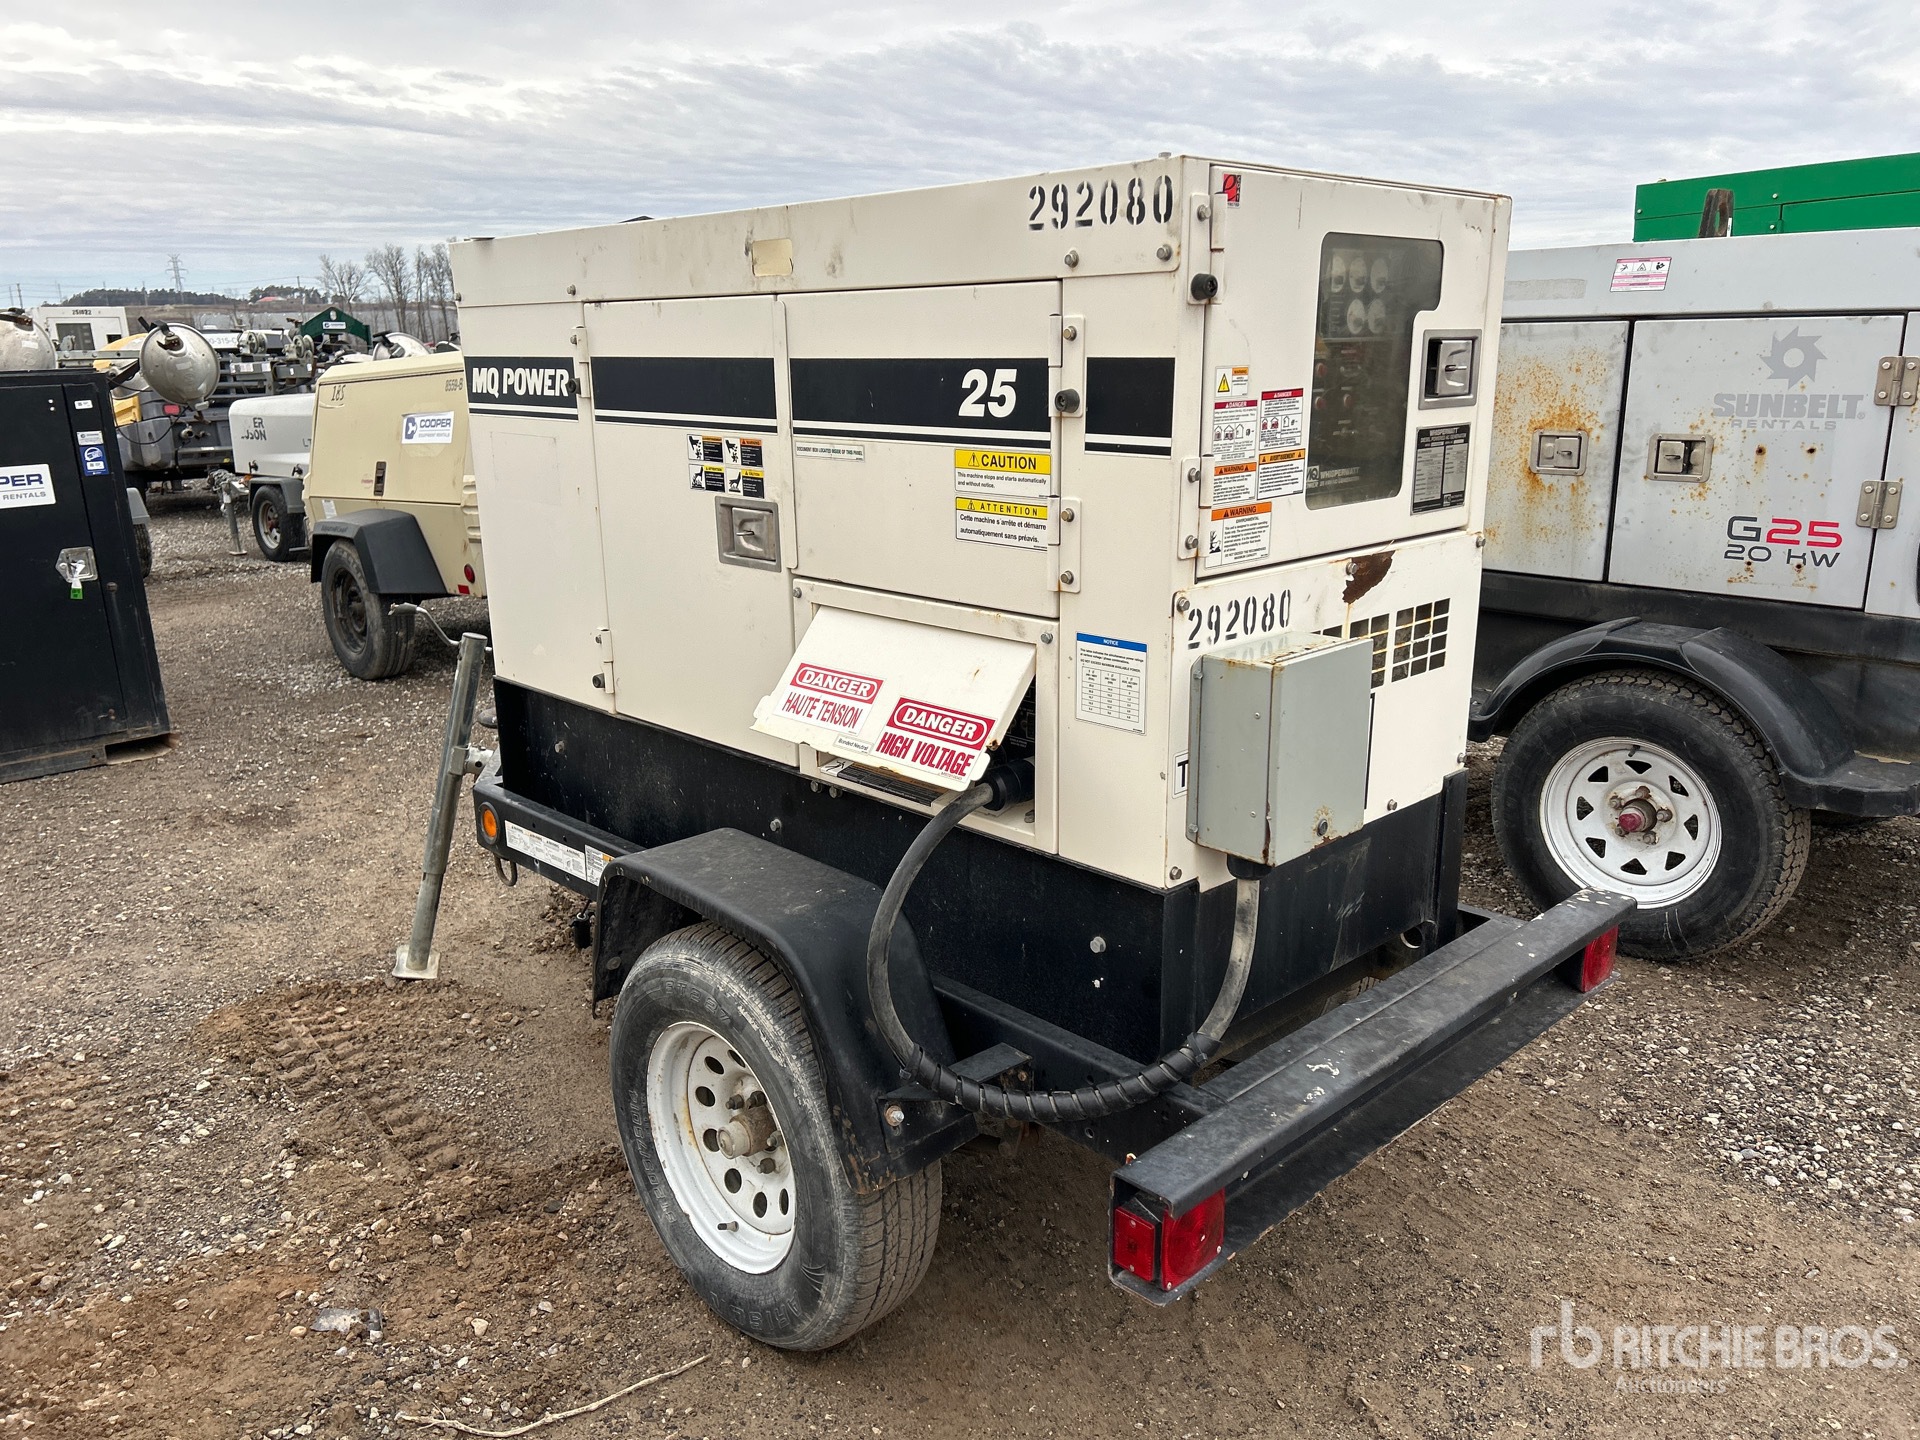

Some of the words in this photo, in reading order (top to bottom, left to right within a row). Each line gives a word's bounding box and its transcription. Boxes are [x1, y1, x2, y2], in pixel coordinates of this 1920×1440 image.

[1029, 174, 1174, 231] 292080
[472, 367, 500, 398] MQ
[503, 367, 569, 397] POWER
[958, 368, 1018, 418] 25
[420, 418, 451, 428] COOPER
[1731, 419, 1837, 430] RENTALS
[981, 454, 1036, 470] CAUTION
[966, 472, 983, 480] machine
[1018, 476, 1046, 484] automatically
[3, 492, 46, 500] RENTALS
[980, 503, 1038, 516] ATTENTION
[1230, 506, 1257, 516] WARNING
[974, 516, 996, 524] machine
[960, 527, 1004, 538] automatiquement
[1727, 515, 1843, 548] G25
[1724, 544, 1772, 562] 20
[1188, 588, 1292, 650] 292080
[802, 670, 872, 698] DANGER
[782, 692, 820, 720] HAUTE
[818, 699, 864, 729] TENSION
[902, 707, 978, 740] DANGER
[876, 731, 909, 760] HIGH
[910, 742, 975, 777] VOLTAGE
